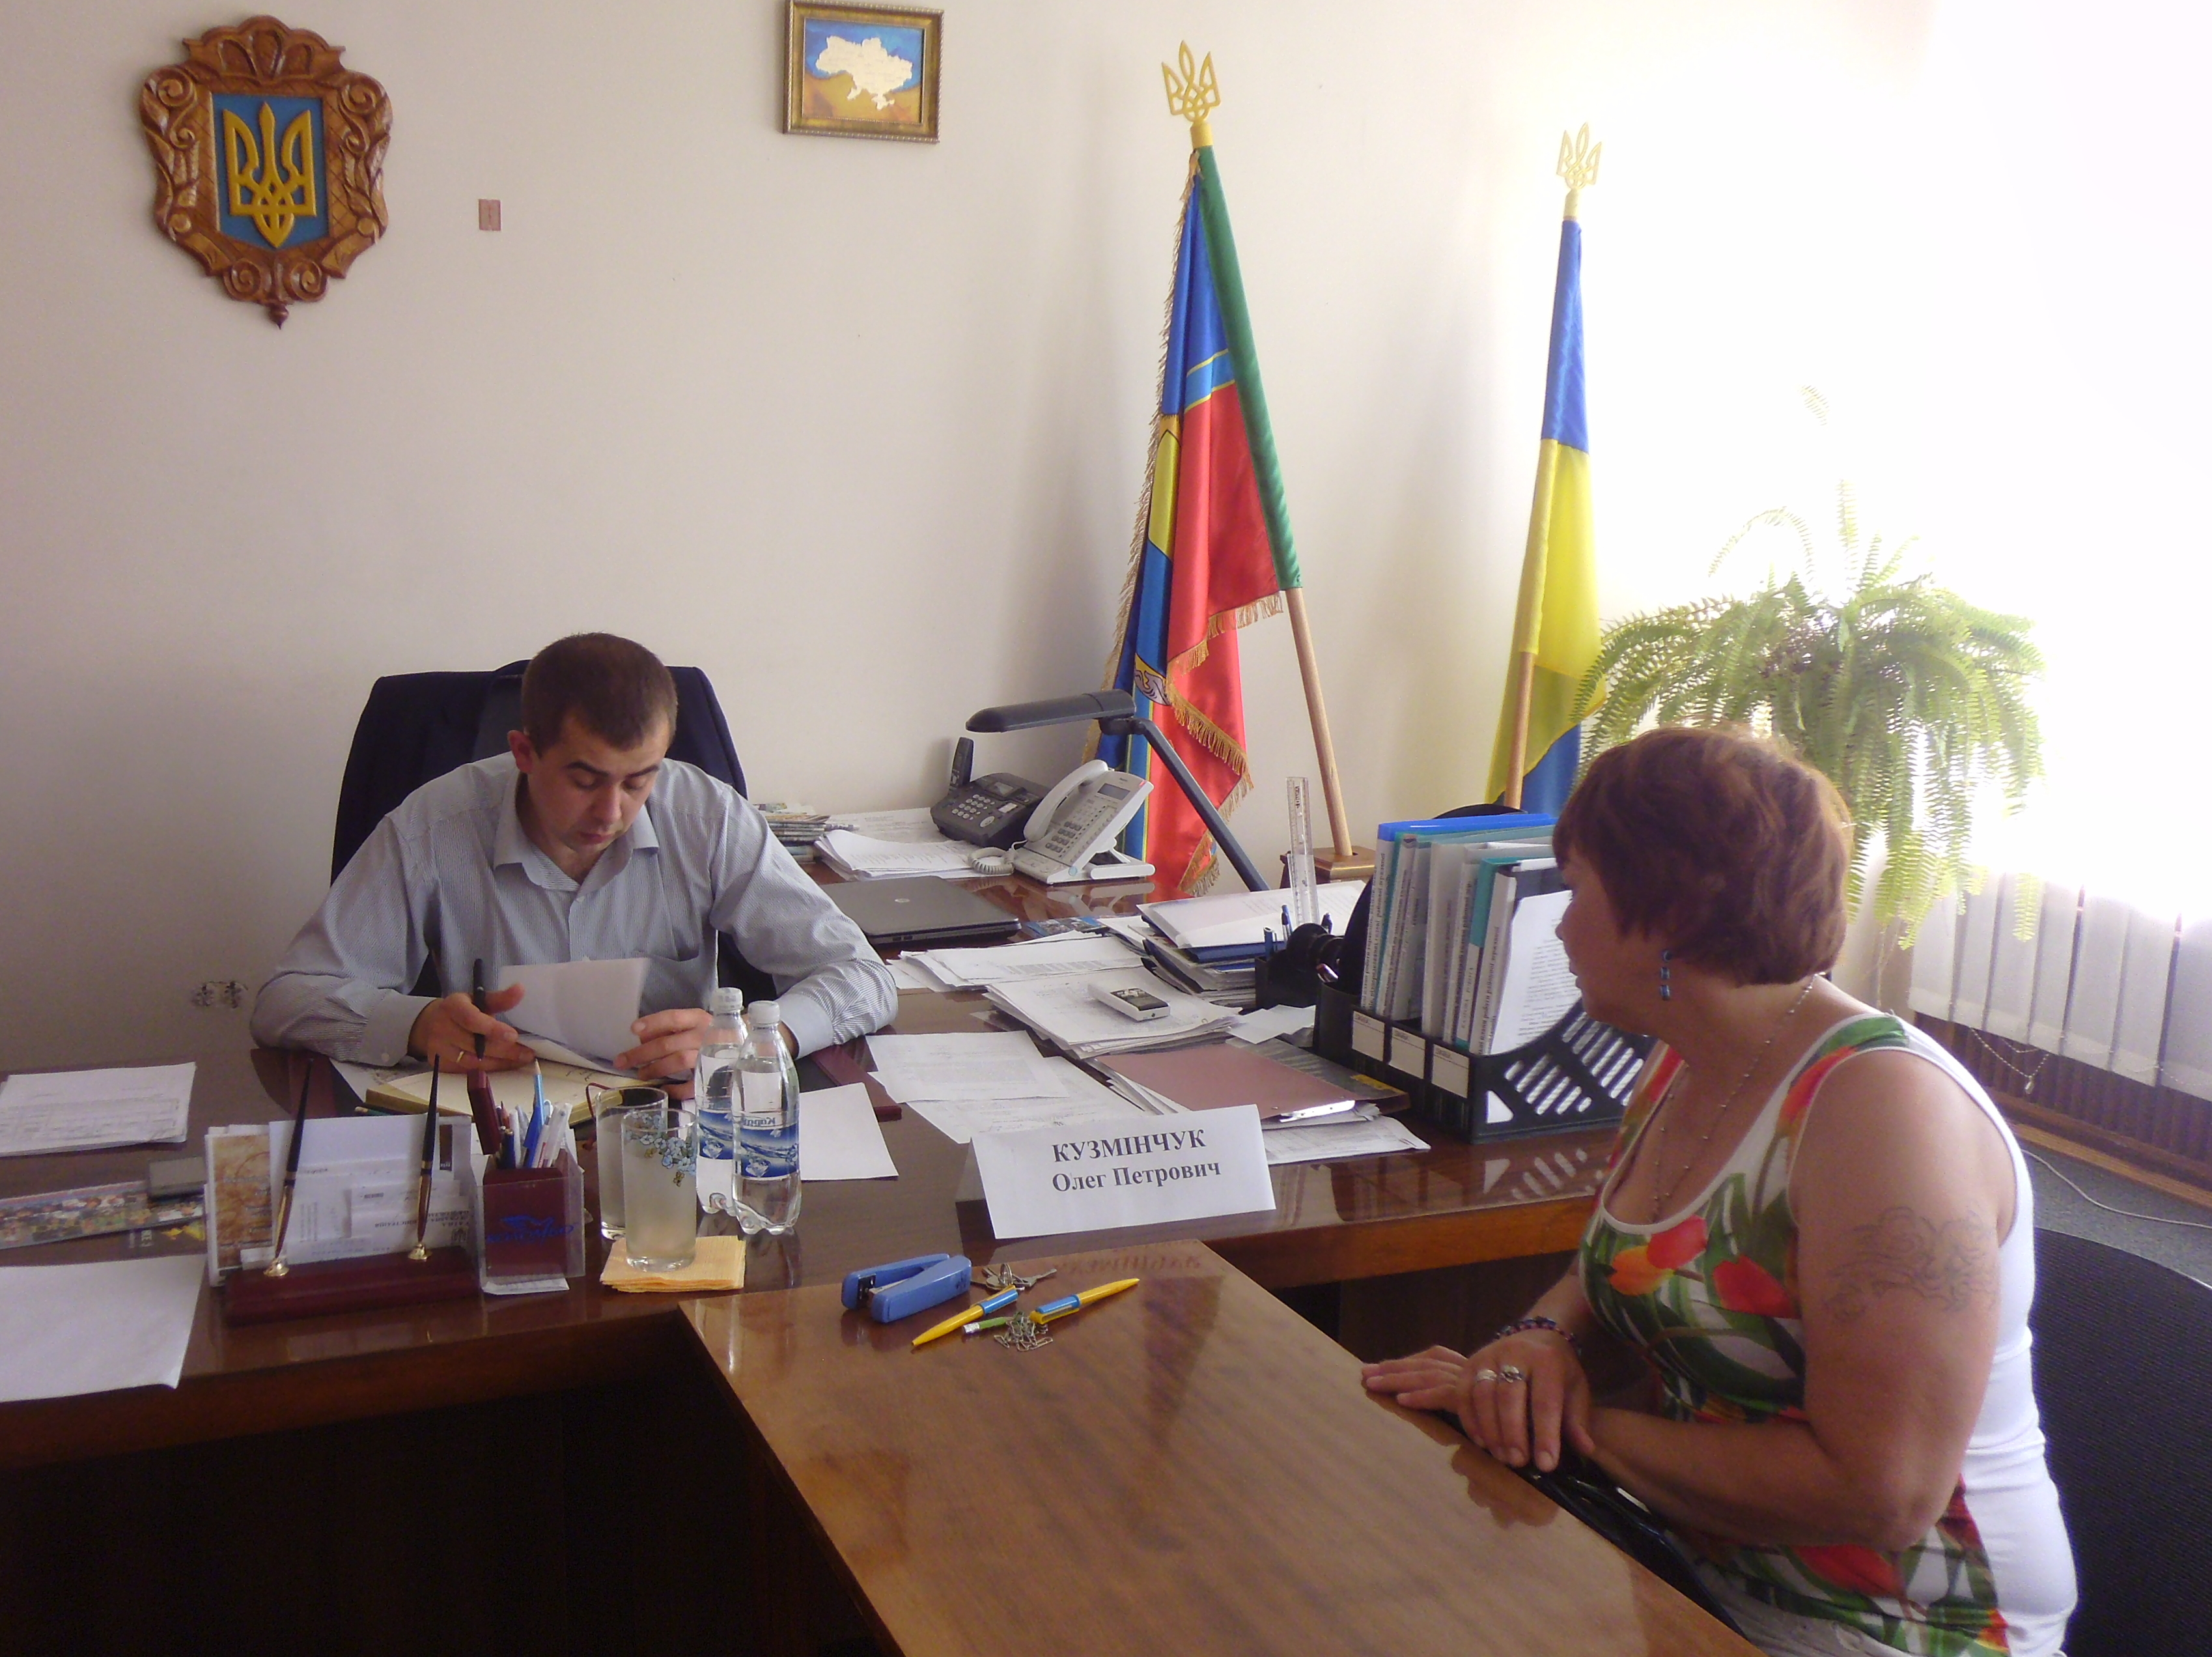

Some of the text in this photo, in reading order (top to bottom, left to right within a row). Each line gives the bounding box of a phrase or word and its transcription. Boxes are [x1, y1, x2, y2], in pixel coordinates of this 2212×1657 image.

[1052, 1129, 1206, 1162] КУЗМІНЧУК
[1052, 1162, 1221, 1192] Олег Петрович
